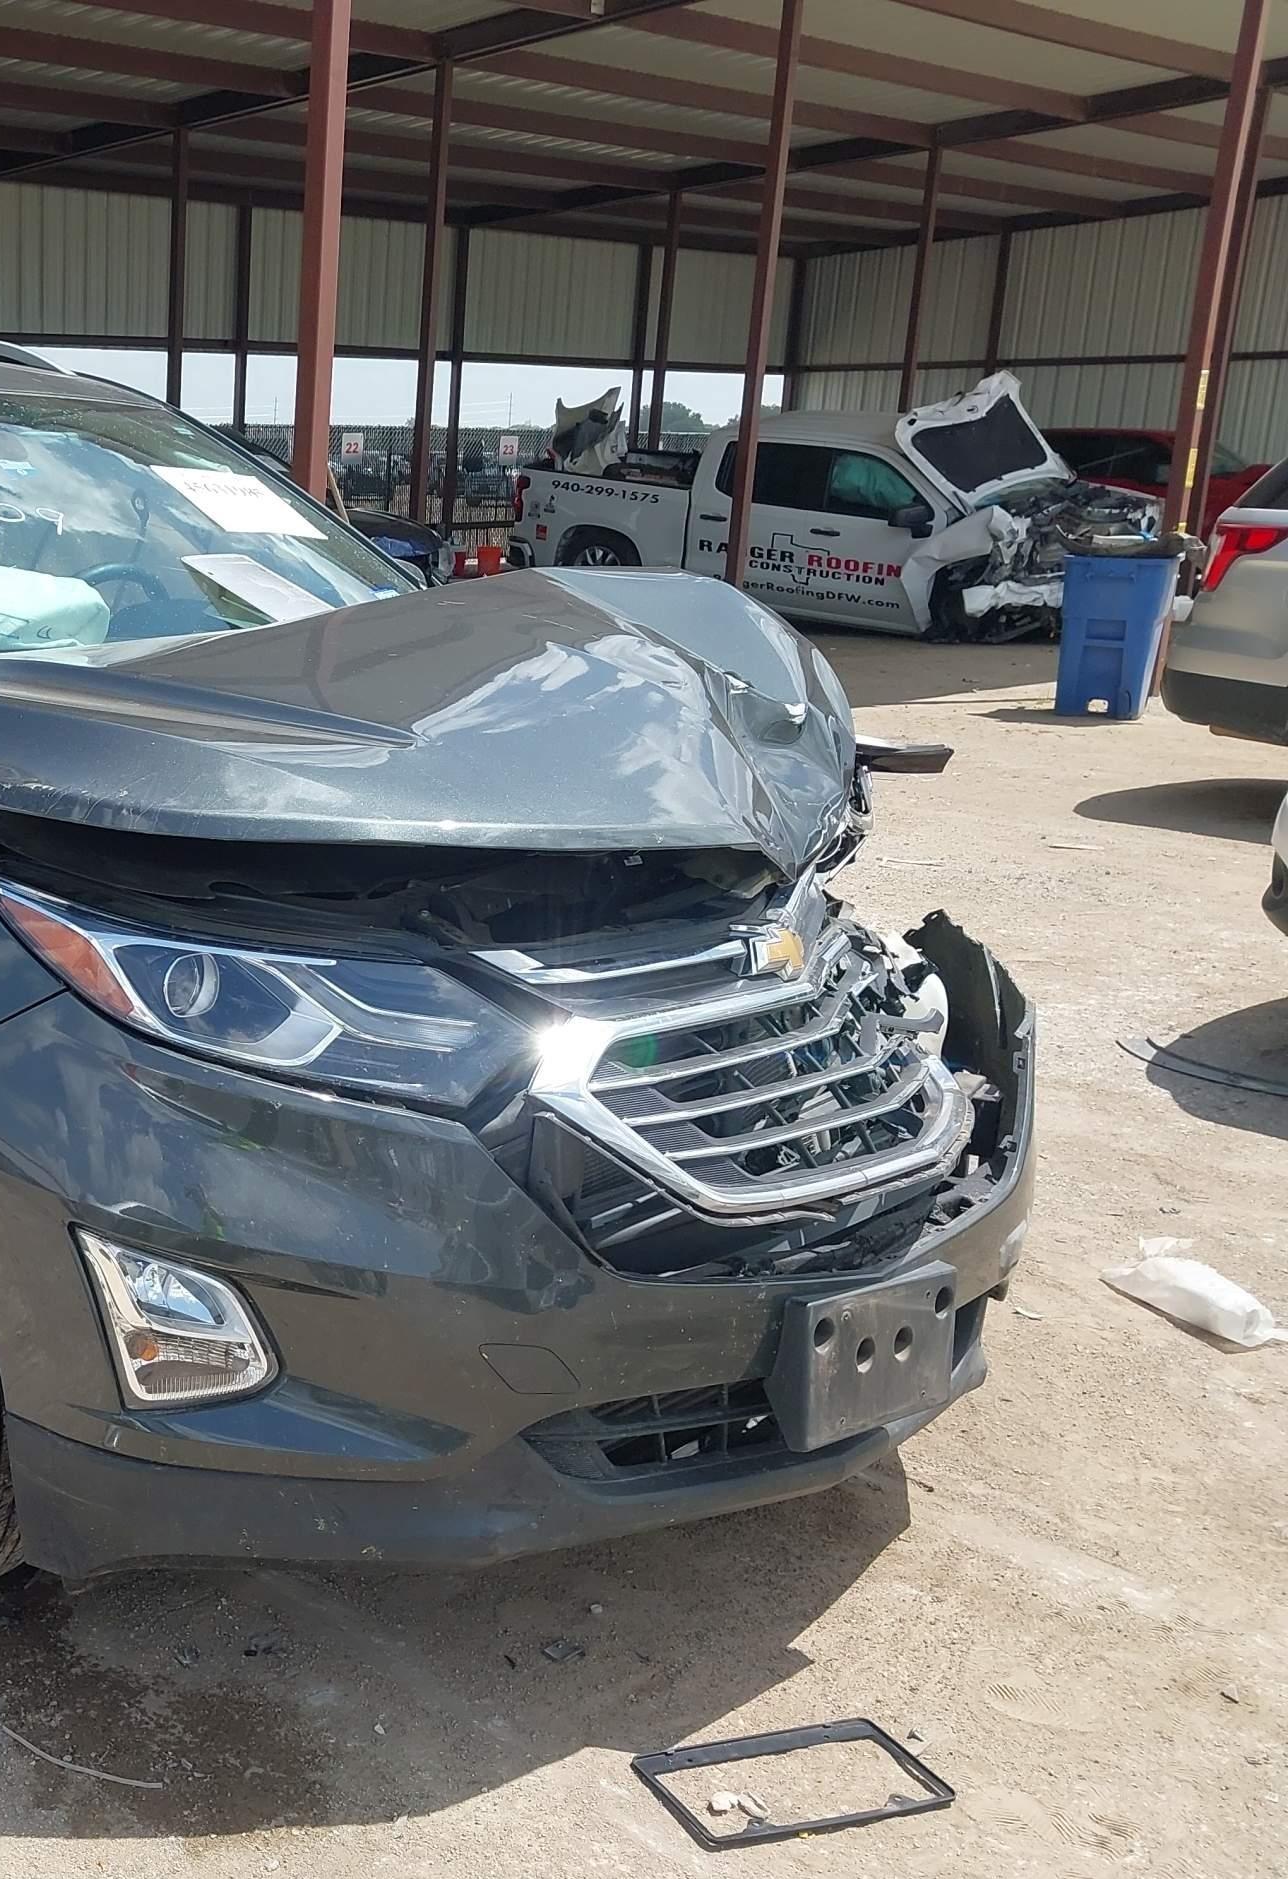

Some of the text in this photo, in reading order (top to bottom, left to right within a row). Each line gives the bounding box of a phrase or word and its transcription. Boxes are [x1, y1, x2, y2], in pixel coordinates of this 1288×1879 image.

[345, 442, 359, 454] 22
[503, 444, 514, 455] 23
[551, 479, 661, 504] 940-299-1575
[698, 539, 902, 578] RAGER ROOFIN
[748, 559, 886, 586] CONSTRUCTION
